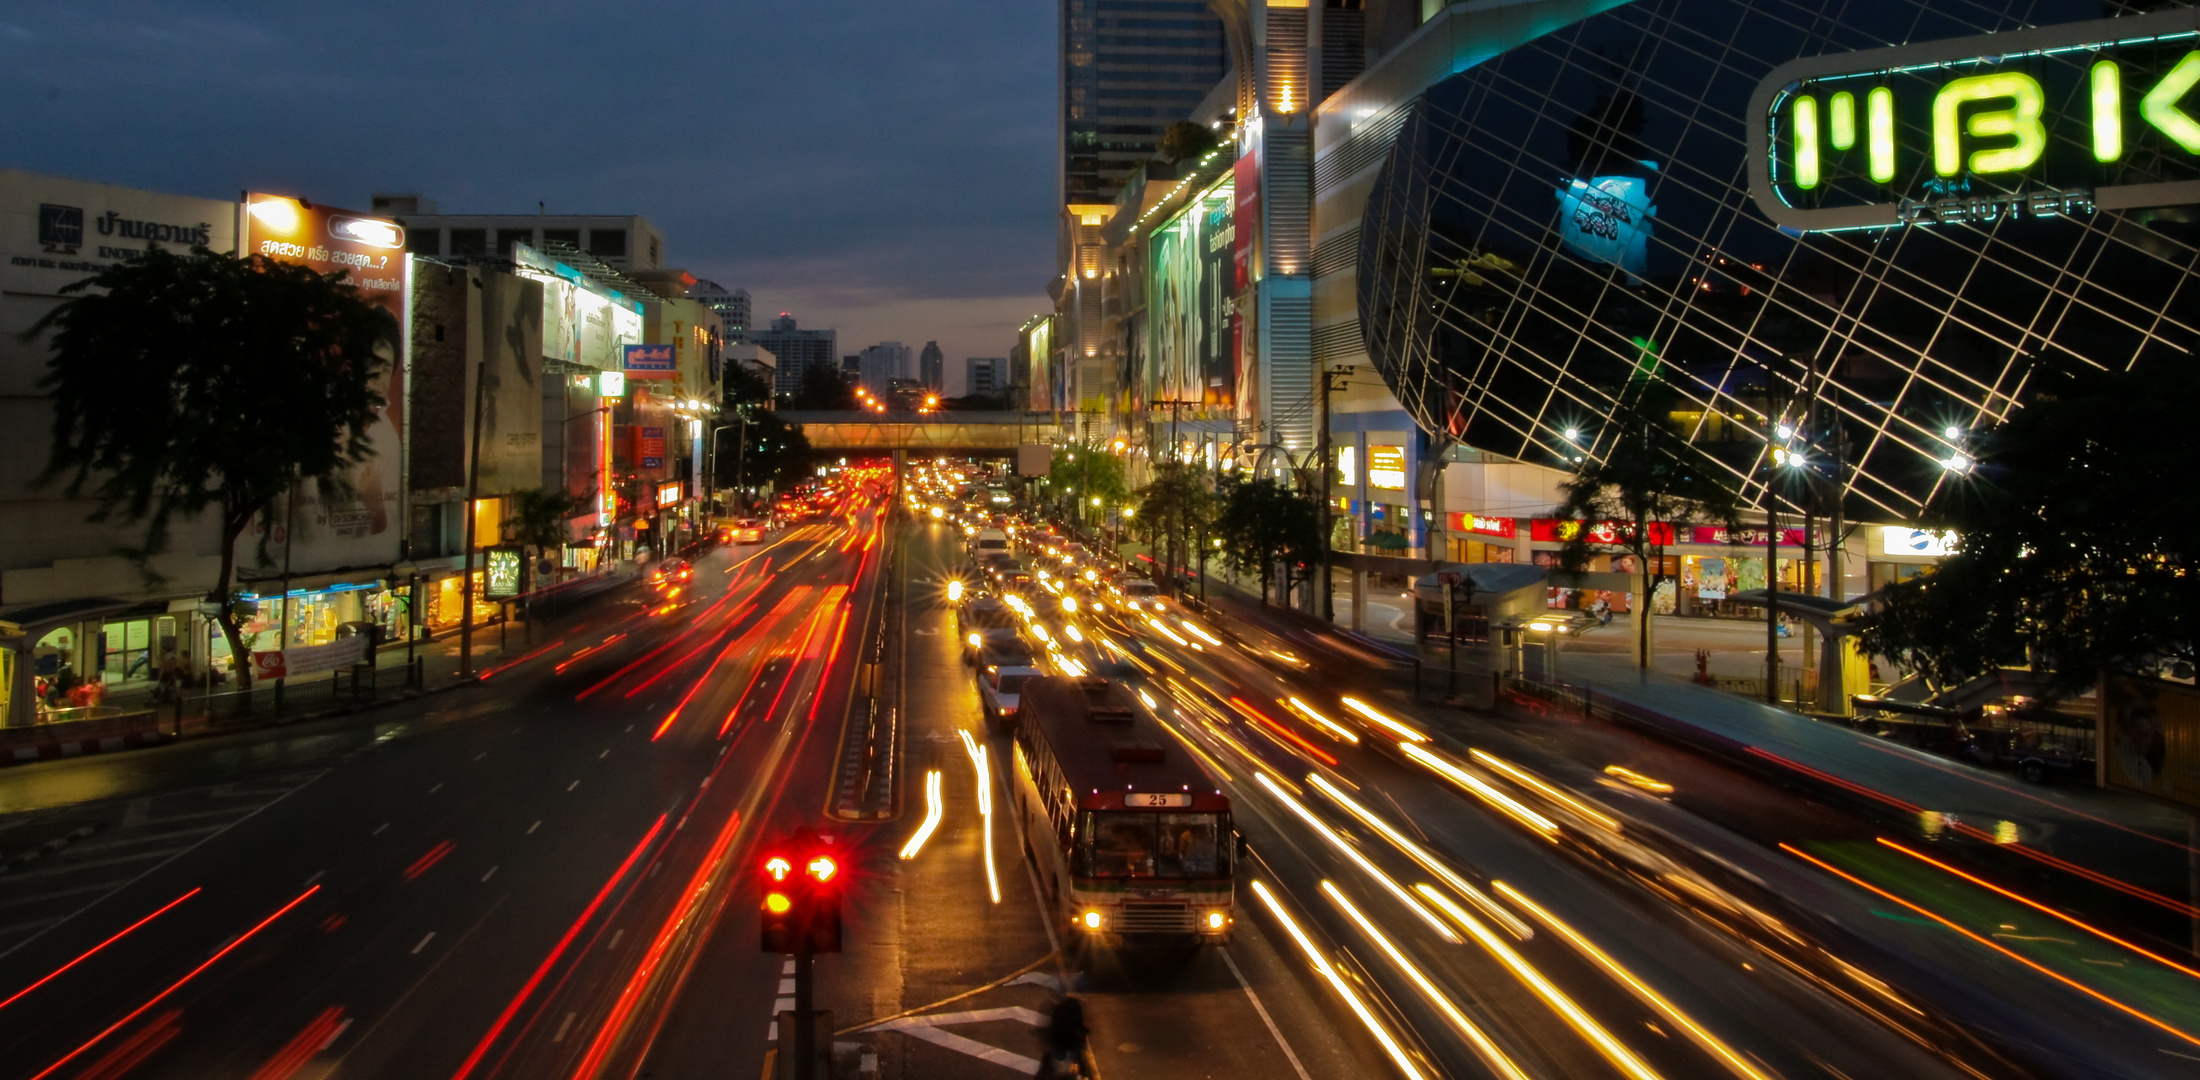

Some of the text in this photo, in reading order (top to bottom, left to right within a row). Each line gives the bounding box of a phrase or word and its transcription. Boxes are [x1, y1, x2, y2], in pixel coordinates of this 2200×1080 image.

[1793, 50, 2200, 189] MBK
[260, 239, 305, 259] สุดสวย
[308, 245, 329, 262] หรือ
[1149, 794, 1167, 806] 25
